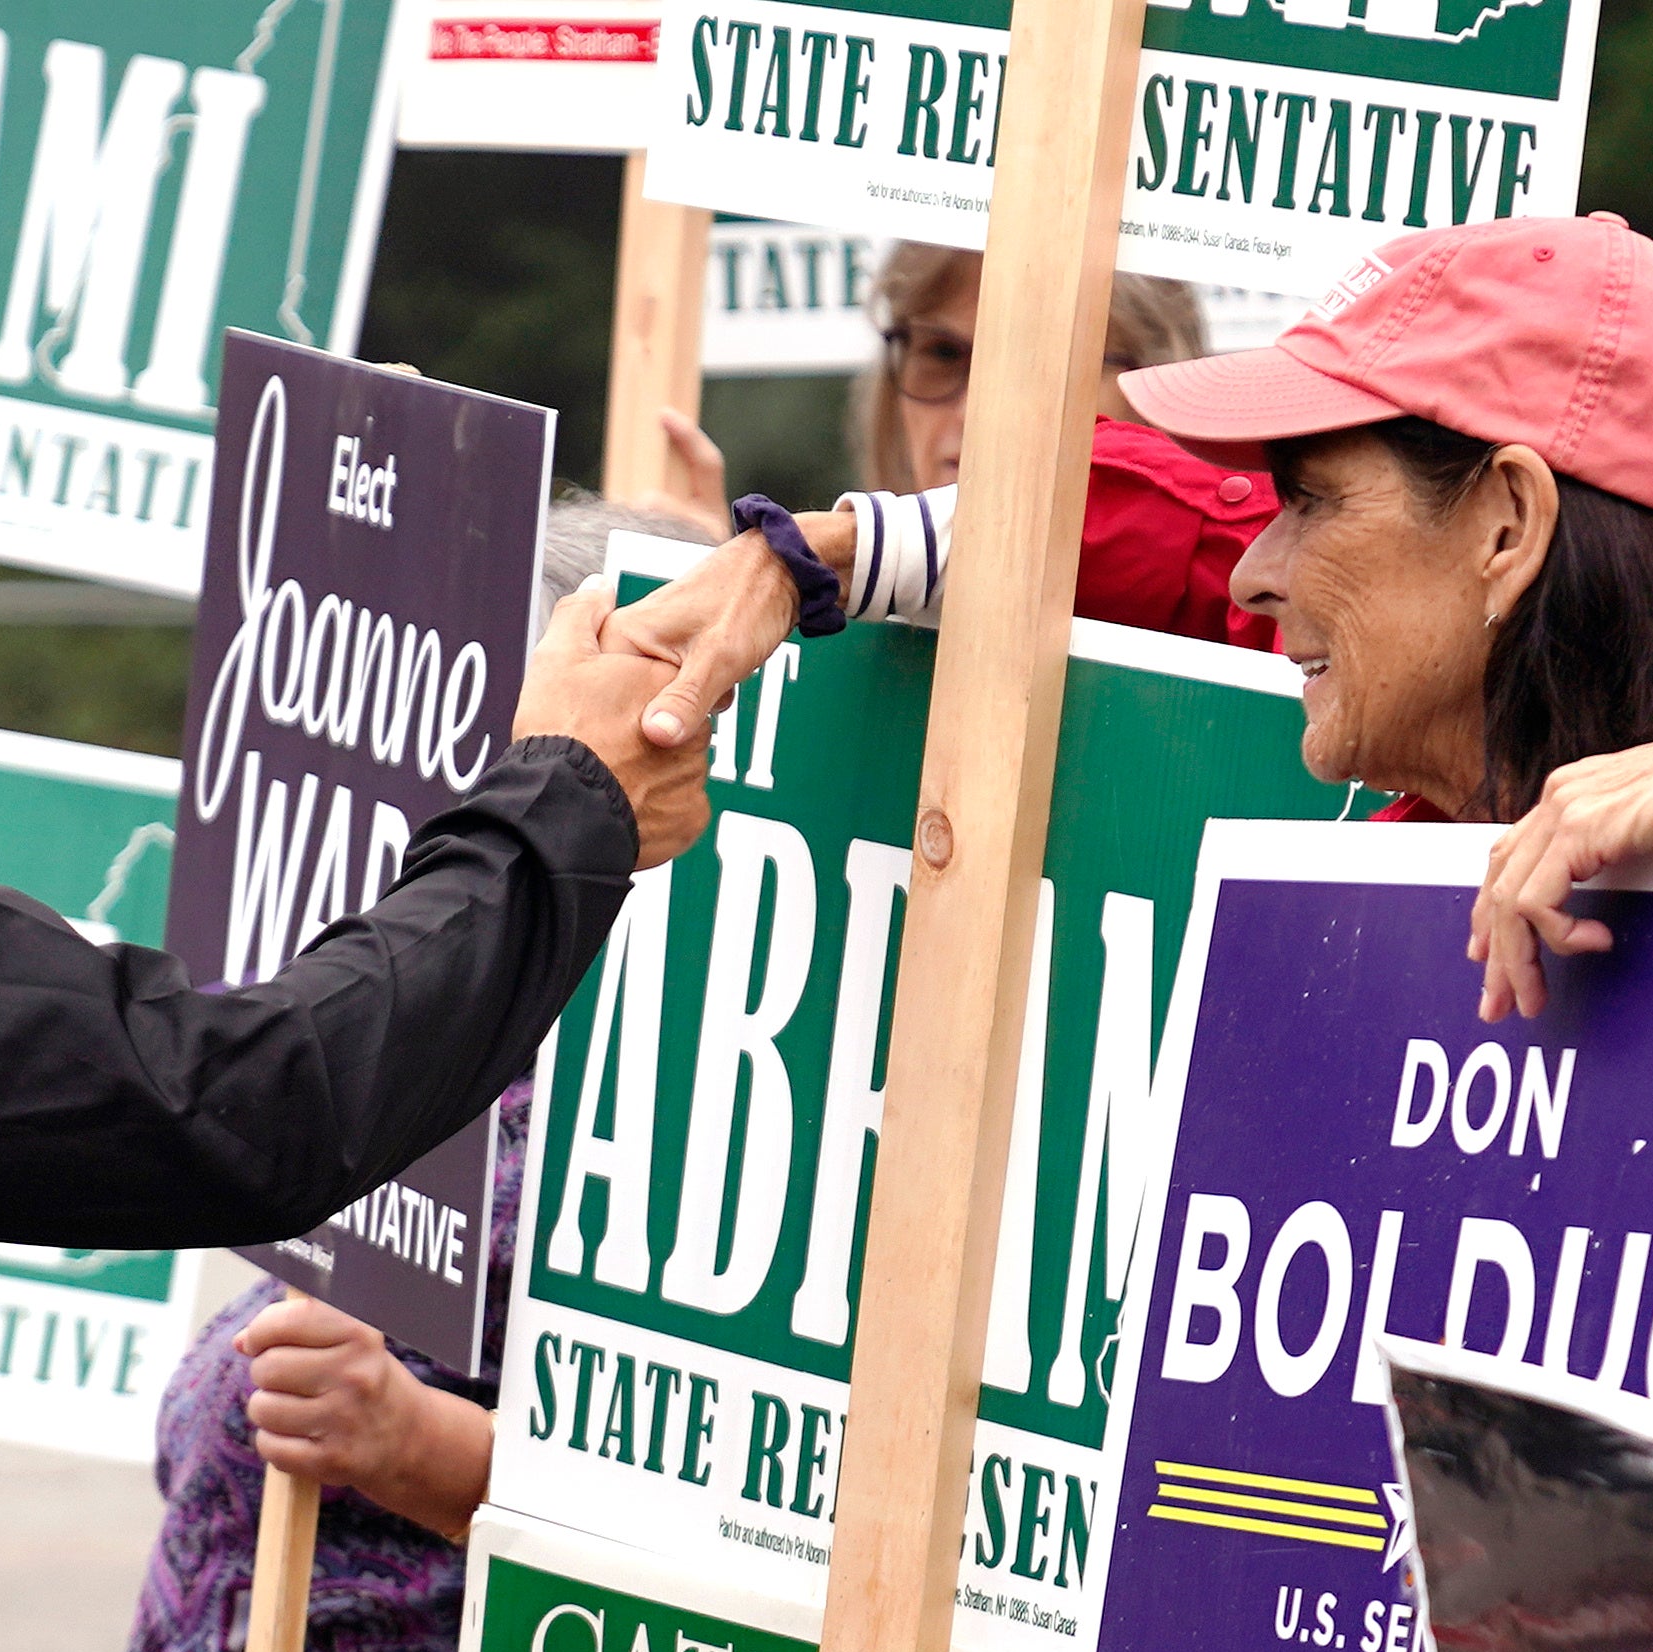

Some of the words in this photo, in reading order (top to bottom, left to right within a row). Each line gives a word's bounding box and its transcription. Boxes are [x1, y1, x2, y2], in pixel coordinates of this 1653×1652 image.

[686, 15, 875, 148] STATE
[326, 434, 397, 531] Elect
[196, 373, 490, 822] Joanne
[1390, 1038, 1577, 1160] DON
[530, 1330, 719, 1487] STATE
[1275, 1585, 1345, 1649] U.S.
